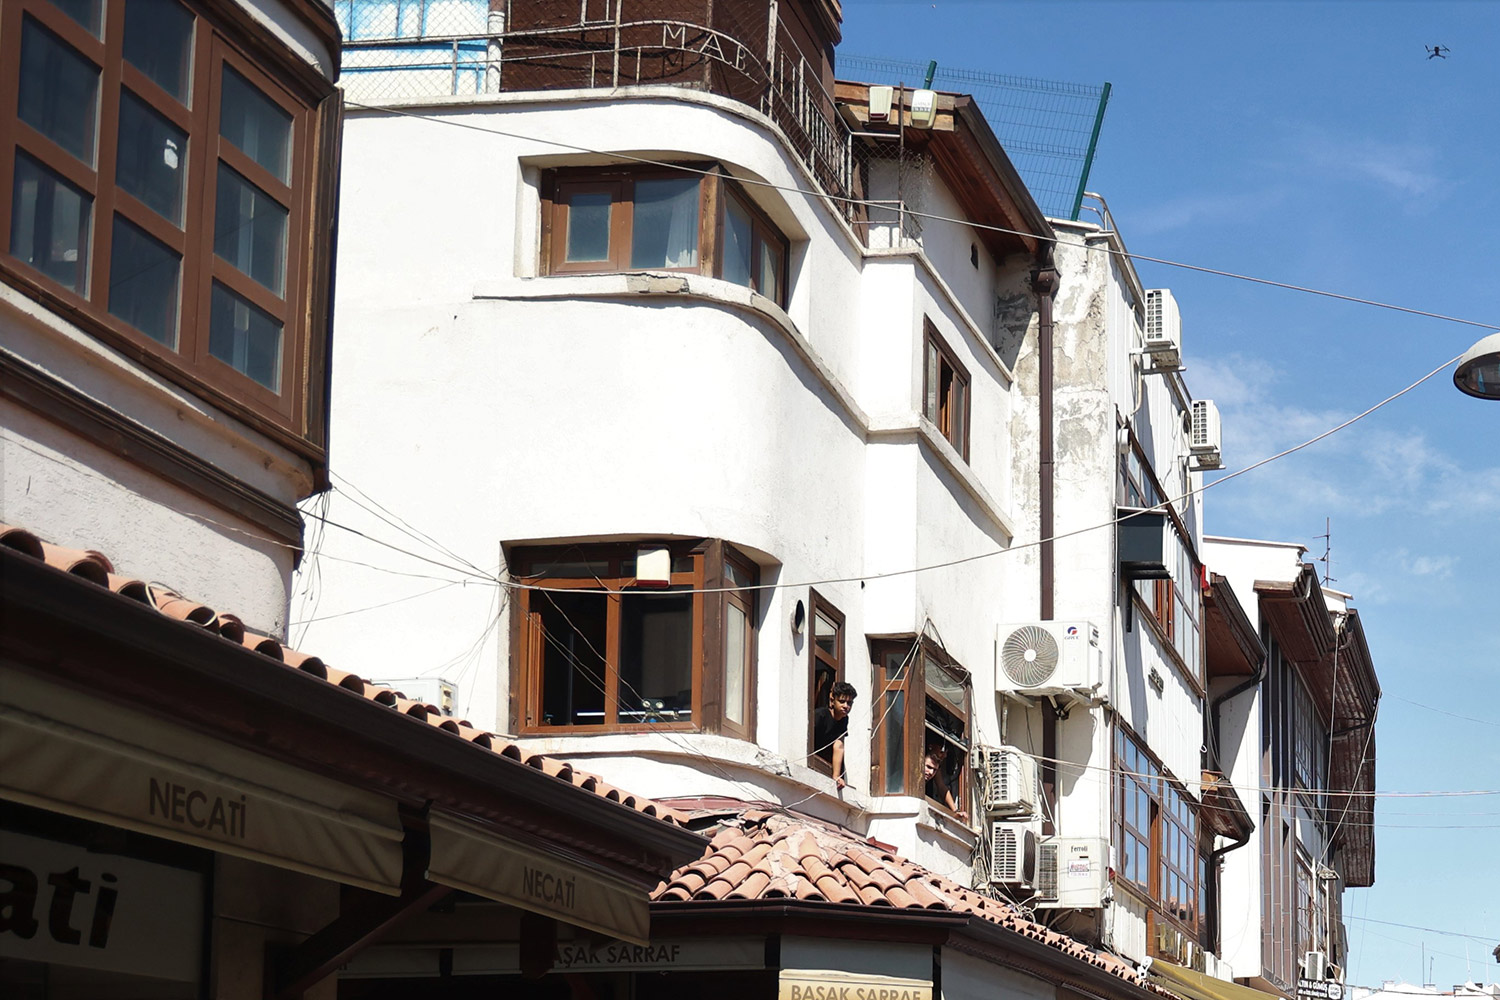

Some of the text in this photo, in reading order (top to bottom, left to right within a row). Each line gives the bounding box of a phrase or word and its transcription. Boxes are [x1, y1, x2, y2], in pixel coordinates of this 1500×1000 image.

[149, 777, 247, 839] NECATİ
[522, 866, 576, 910] NECATİ
[552, 944, 681, 969] AŞAK SARRAF
